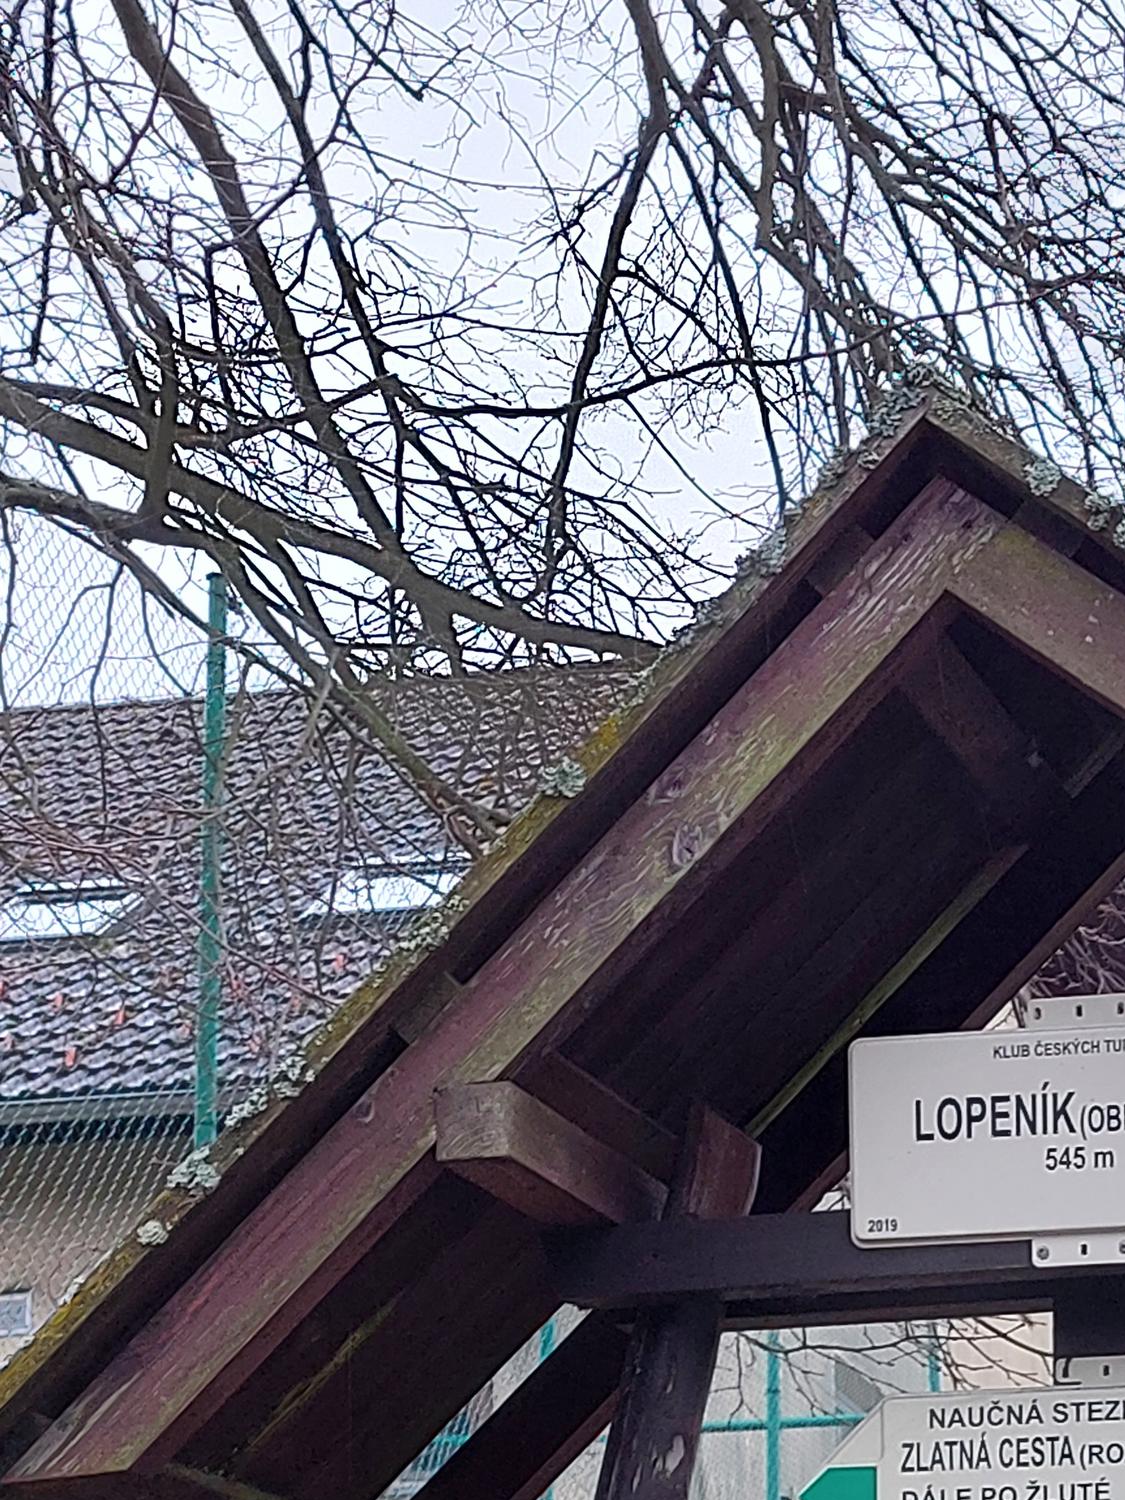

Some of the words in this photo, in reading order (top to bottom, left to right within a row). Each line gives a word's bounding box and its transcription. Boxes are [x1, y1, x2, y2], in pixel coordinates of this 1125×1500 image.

[993, 1044, 1030, 1059] KLUB
[1034, 1039, 1101, 1057] ČESKÝCH
[914, 1082, 1076, 1142] LOPENÍK
[1045, 1146, 1086, 1171] 545
[1094, 1148, 1114, 1169] m
[867, 1218, 899, 1233] 2019
[929, 1403, 1044, 1430] NAUČNÁ
[900, 1432, 990, 1474] ZLATNÁ
[999, 1434, 1075, 1469] CESTA
